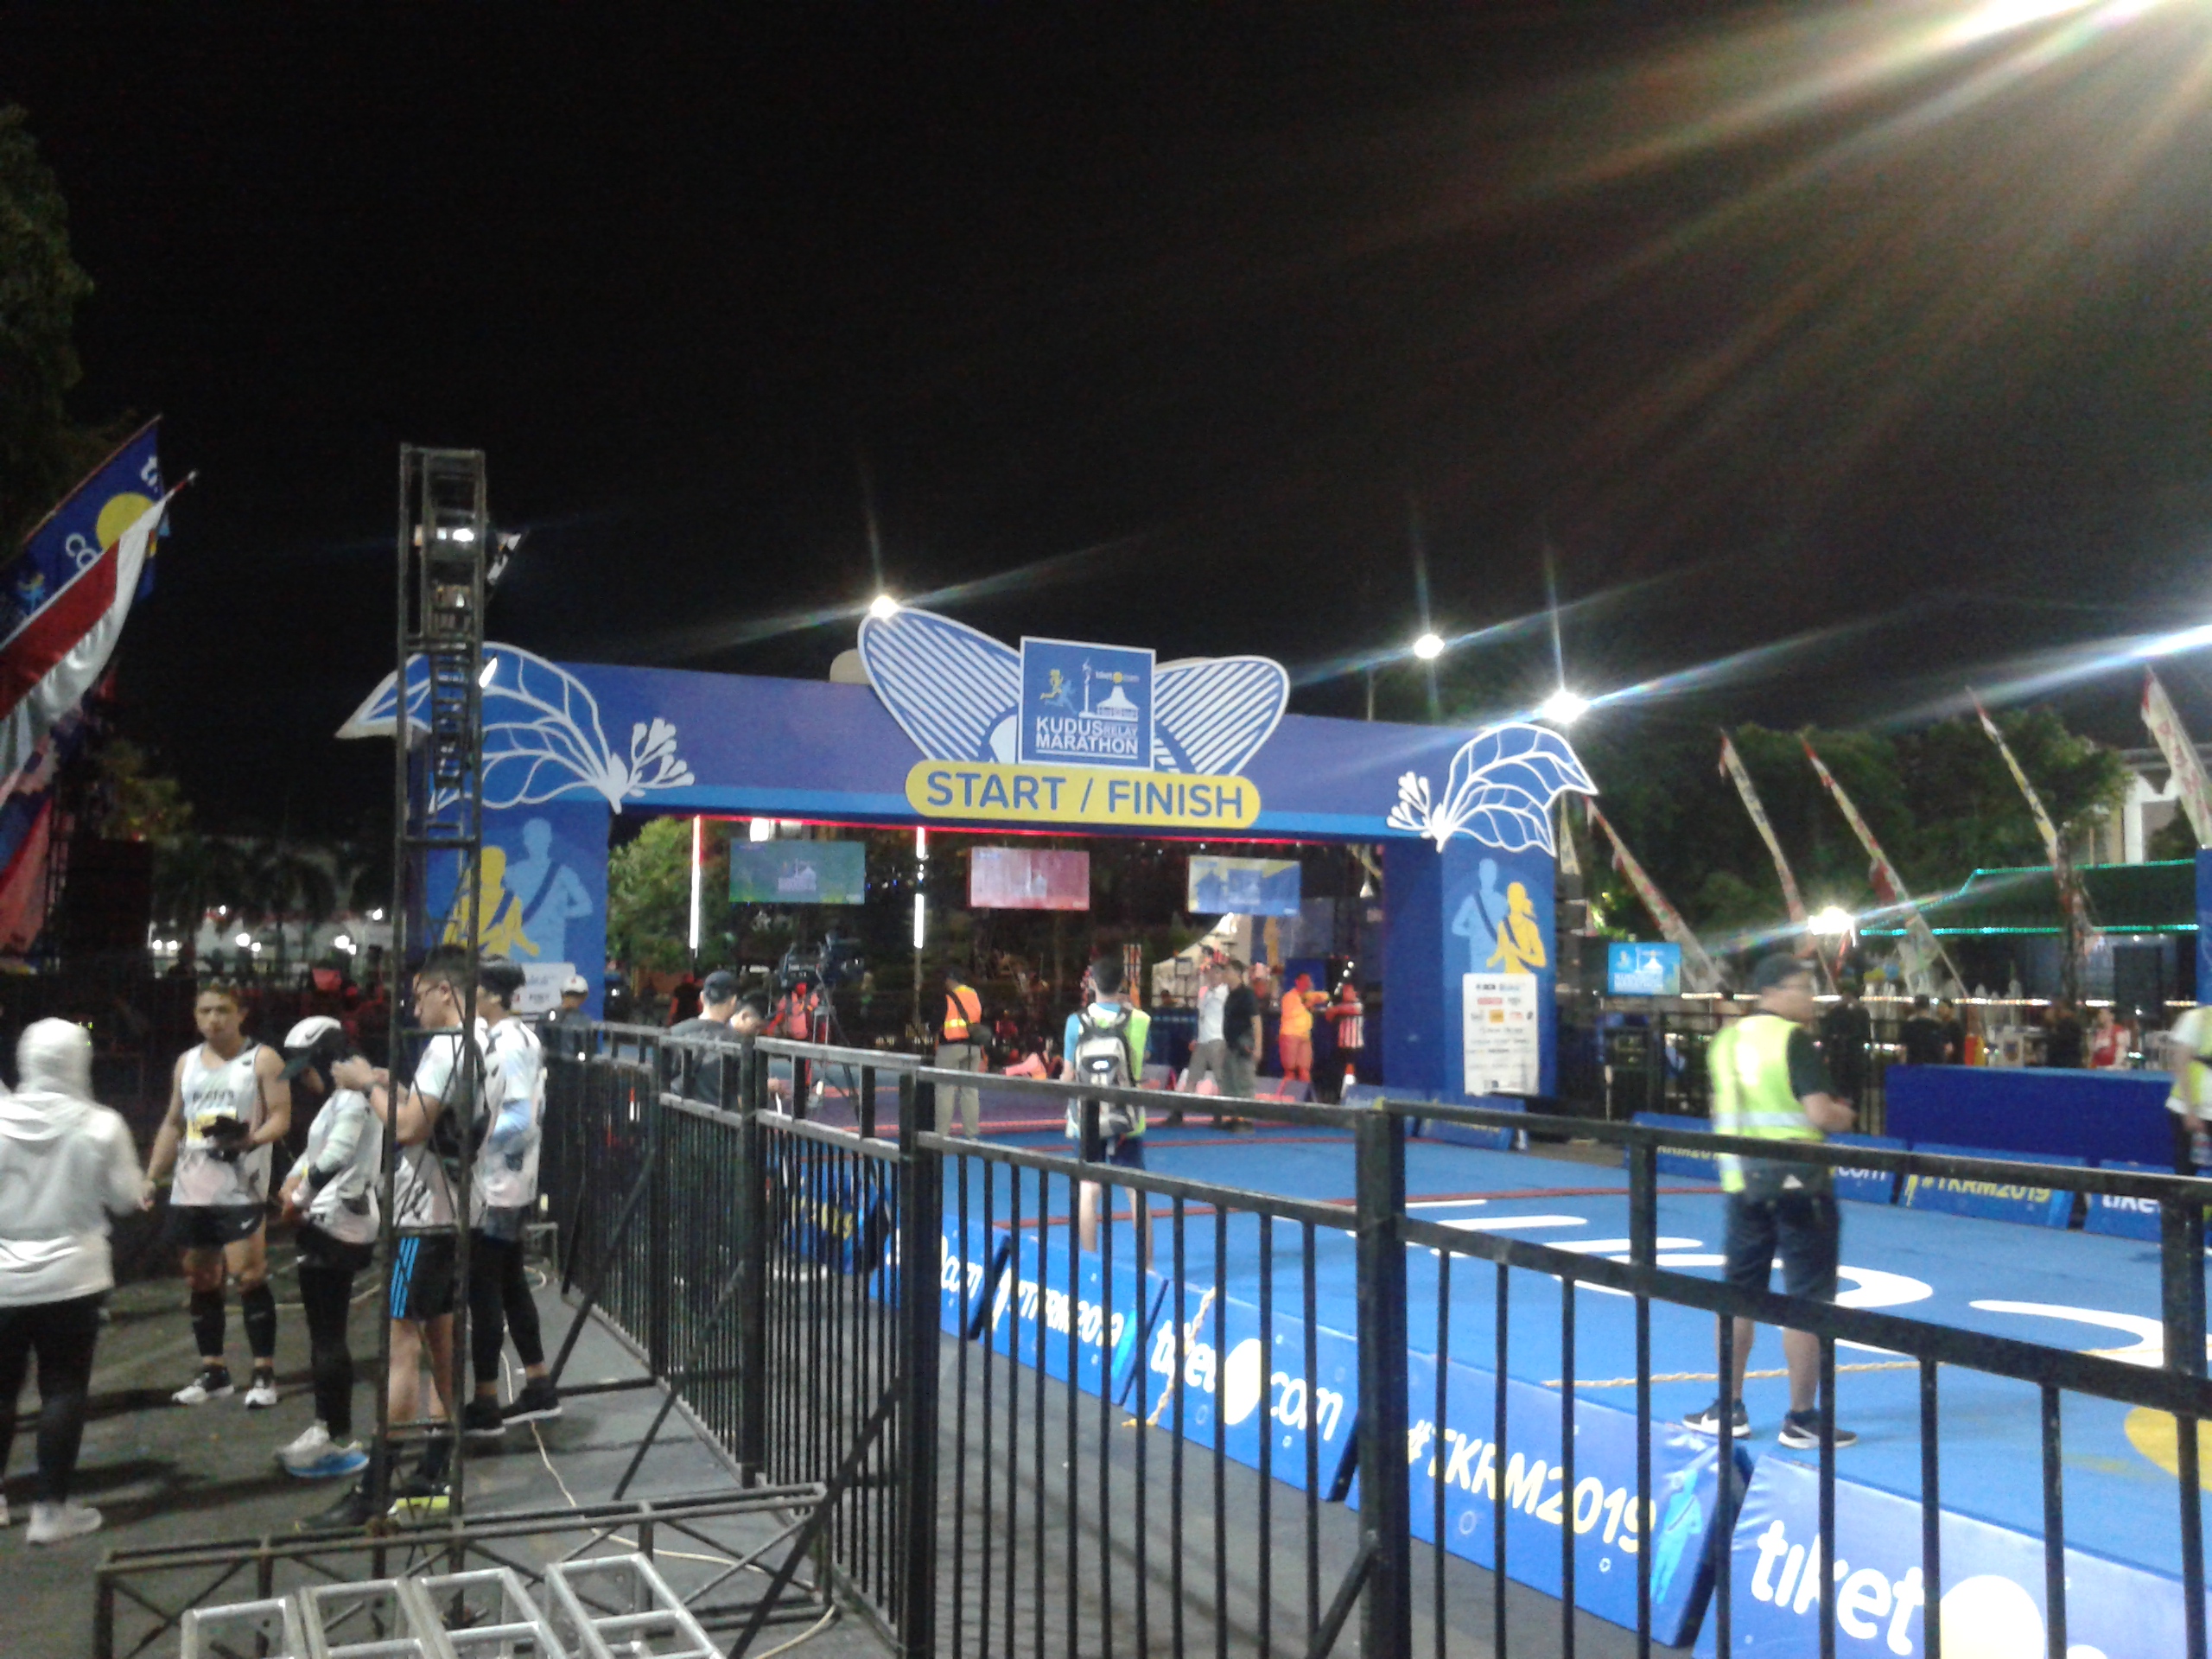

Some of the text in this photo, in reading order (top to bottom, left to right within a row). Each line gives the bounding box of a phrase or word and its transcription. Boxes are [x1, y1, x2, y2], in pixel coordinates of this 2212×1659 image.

[1036, 733, 1139, 755] MARATHON
[1037, 715, 1138, 739] KUDUS RELAY
[926, 770, 1243, 819] START / FINISH
[1751, 1519, 1925, 1656] tiket
